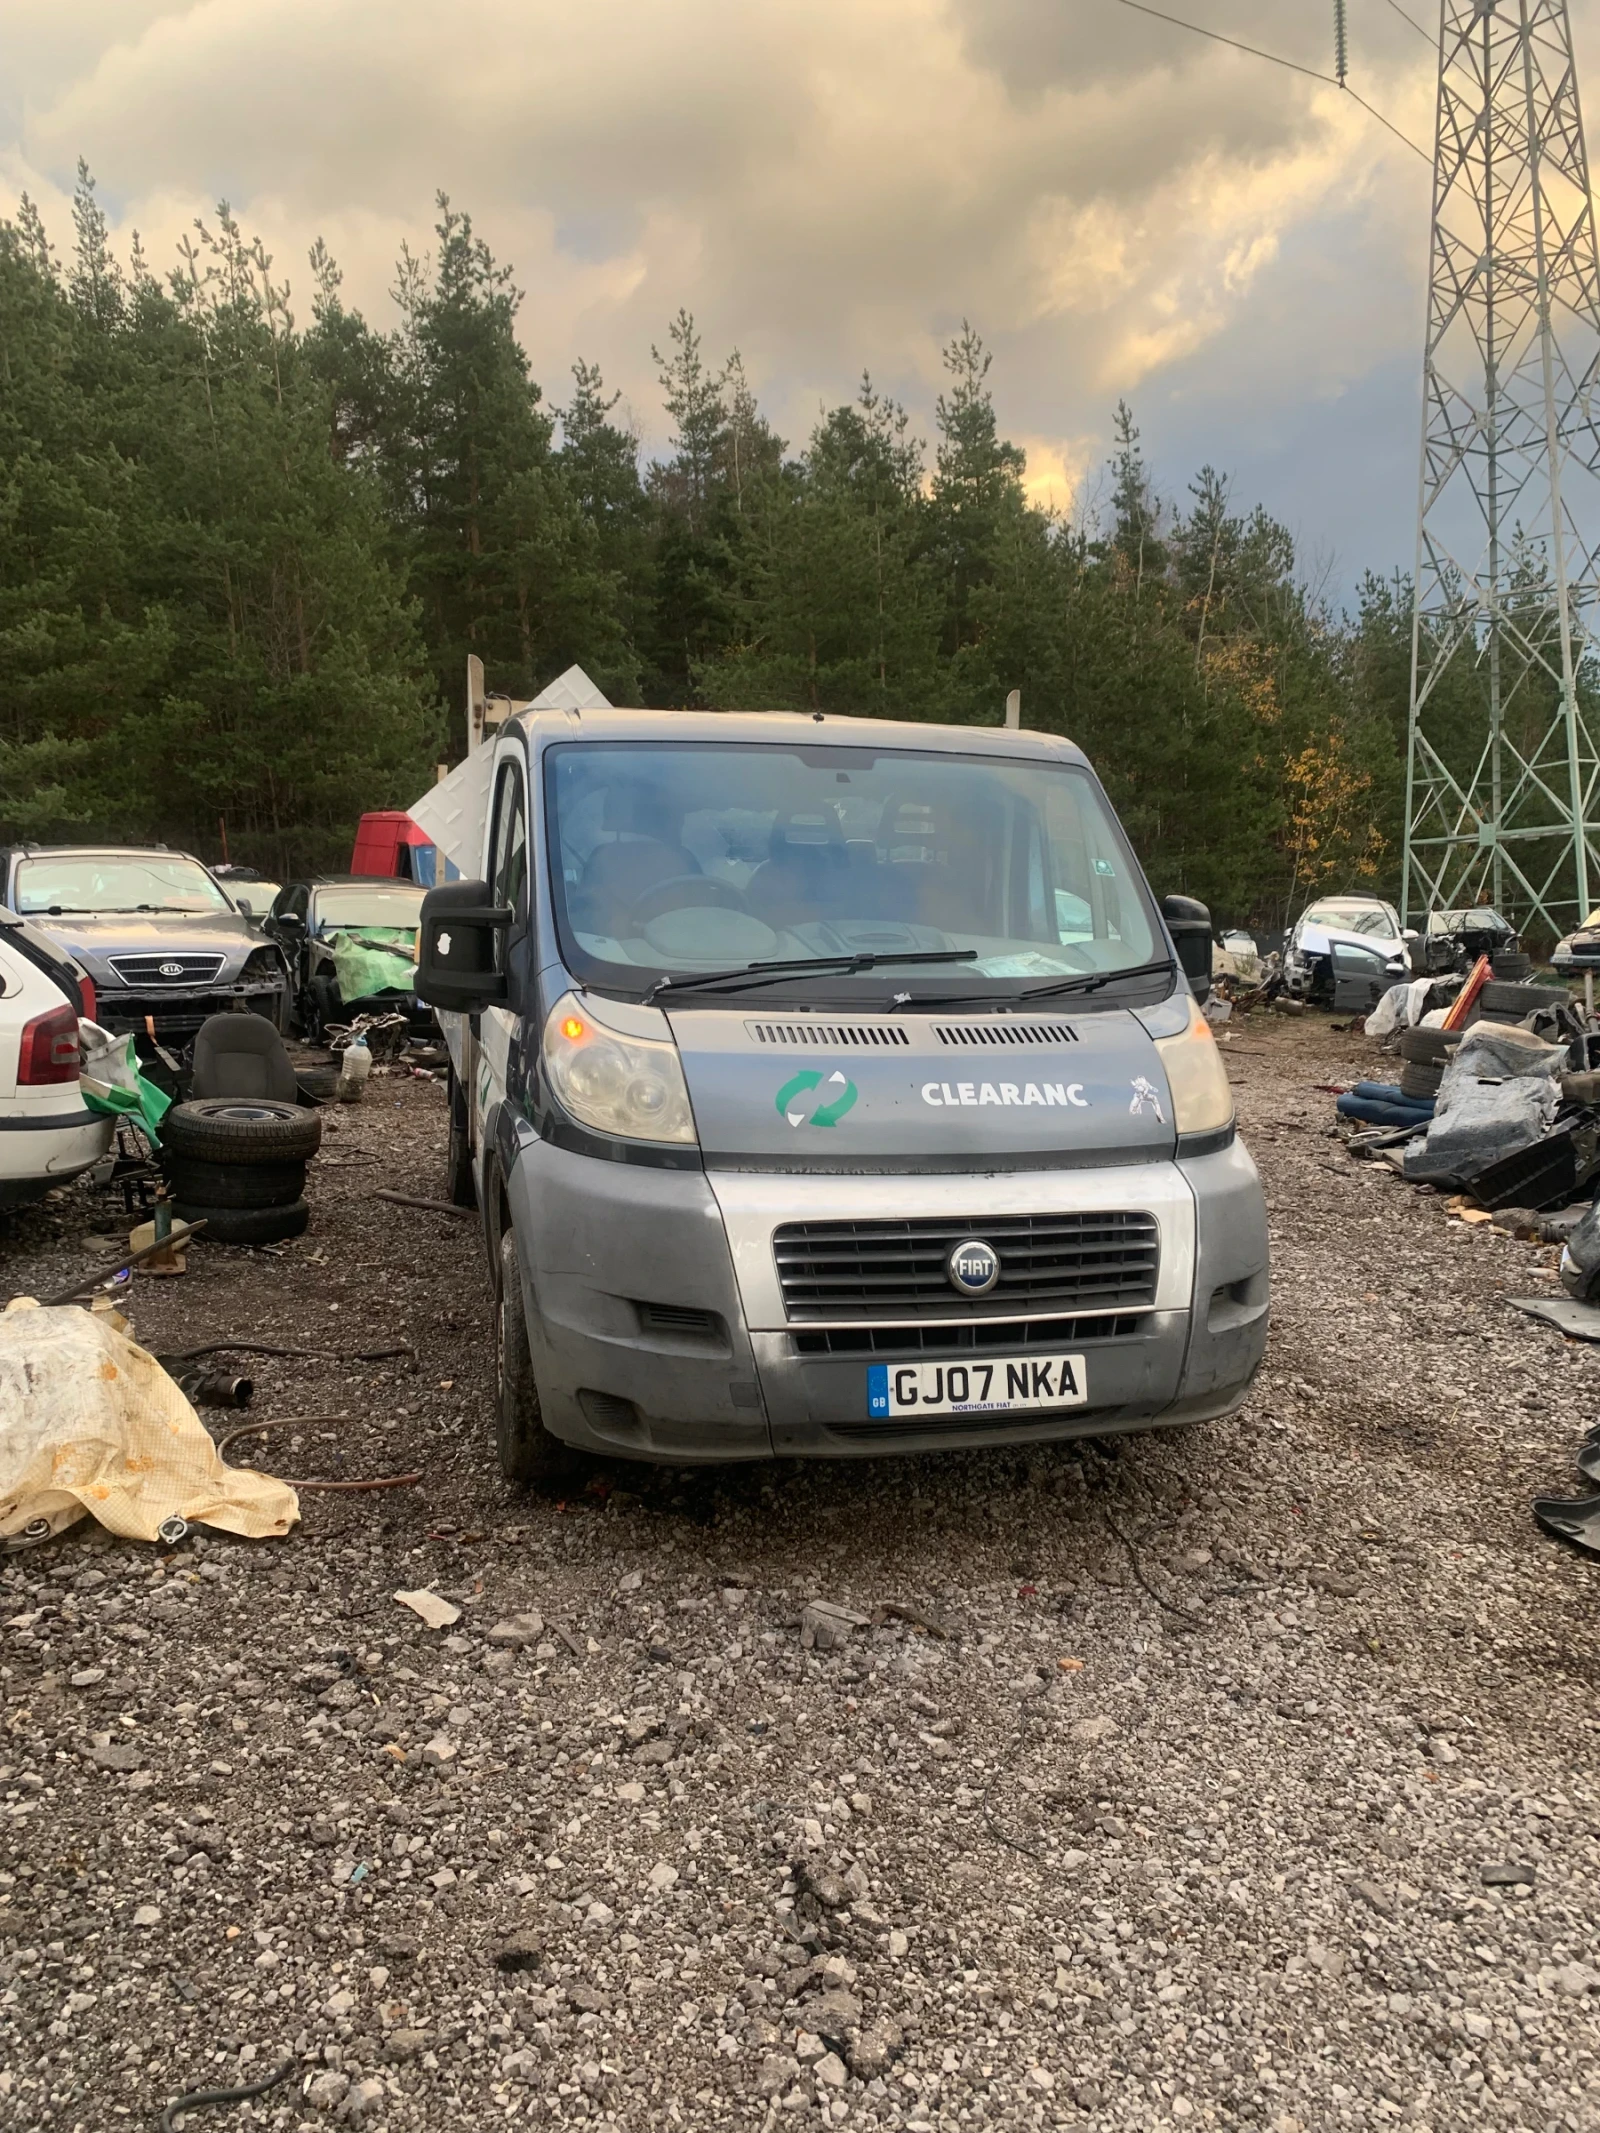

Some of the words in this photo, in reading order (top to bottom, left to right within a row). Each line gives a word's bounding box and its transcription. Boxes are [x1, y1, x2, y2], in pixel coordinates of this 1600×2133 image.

[921, 1082, 1089, 1107] CLEARANC
[959, 1259, 991, 1276] FIAT
[895, 1364, 994, 1406] GJ07
[1006, 1360, 1079, 1400] NKA
[872, 1397, 886, 1408] GB
[952, 1402, 995, 1412] NORTHGATE
[996, 1401, 1011, 1409] FIAT
